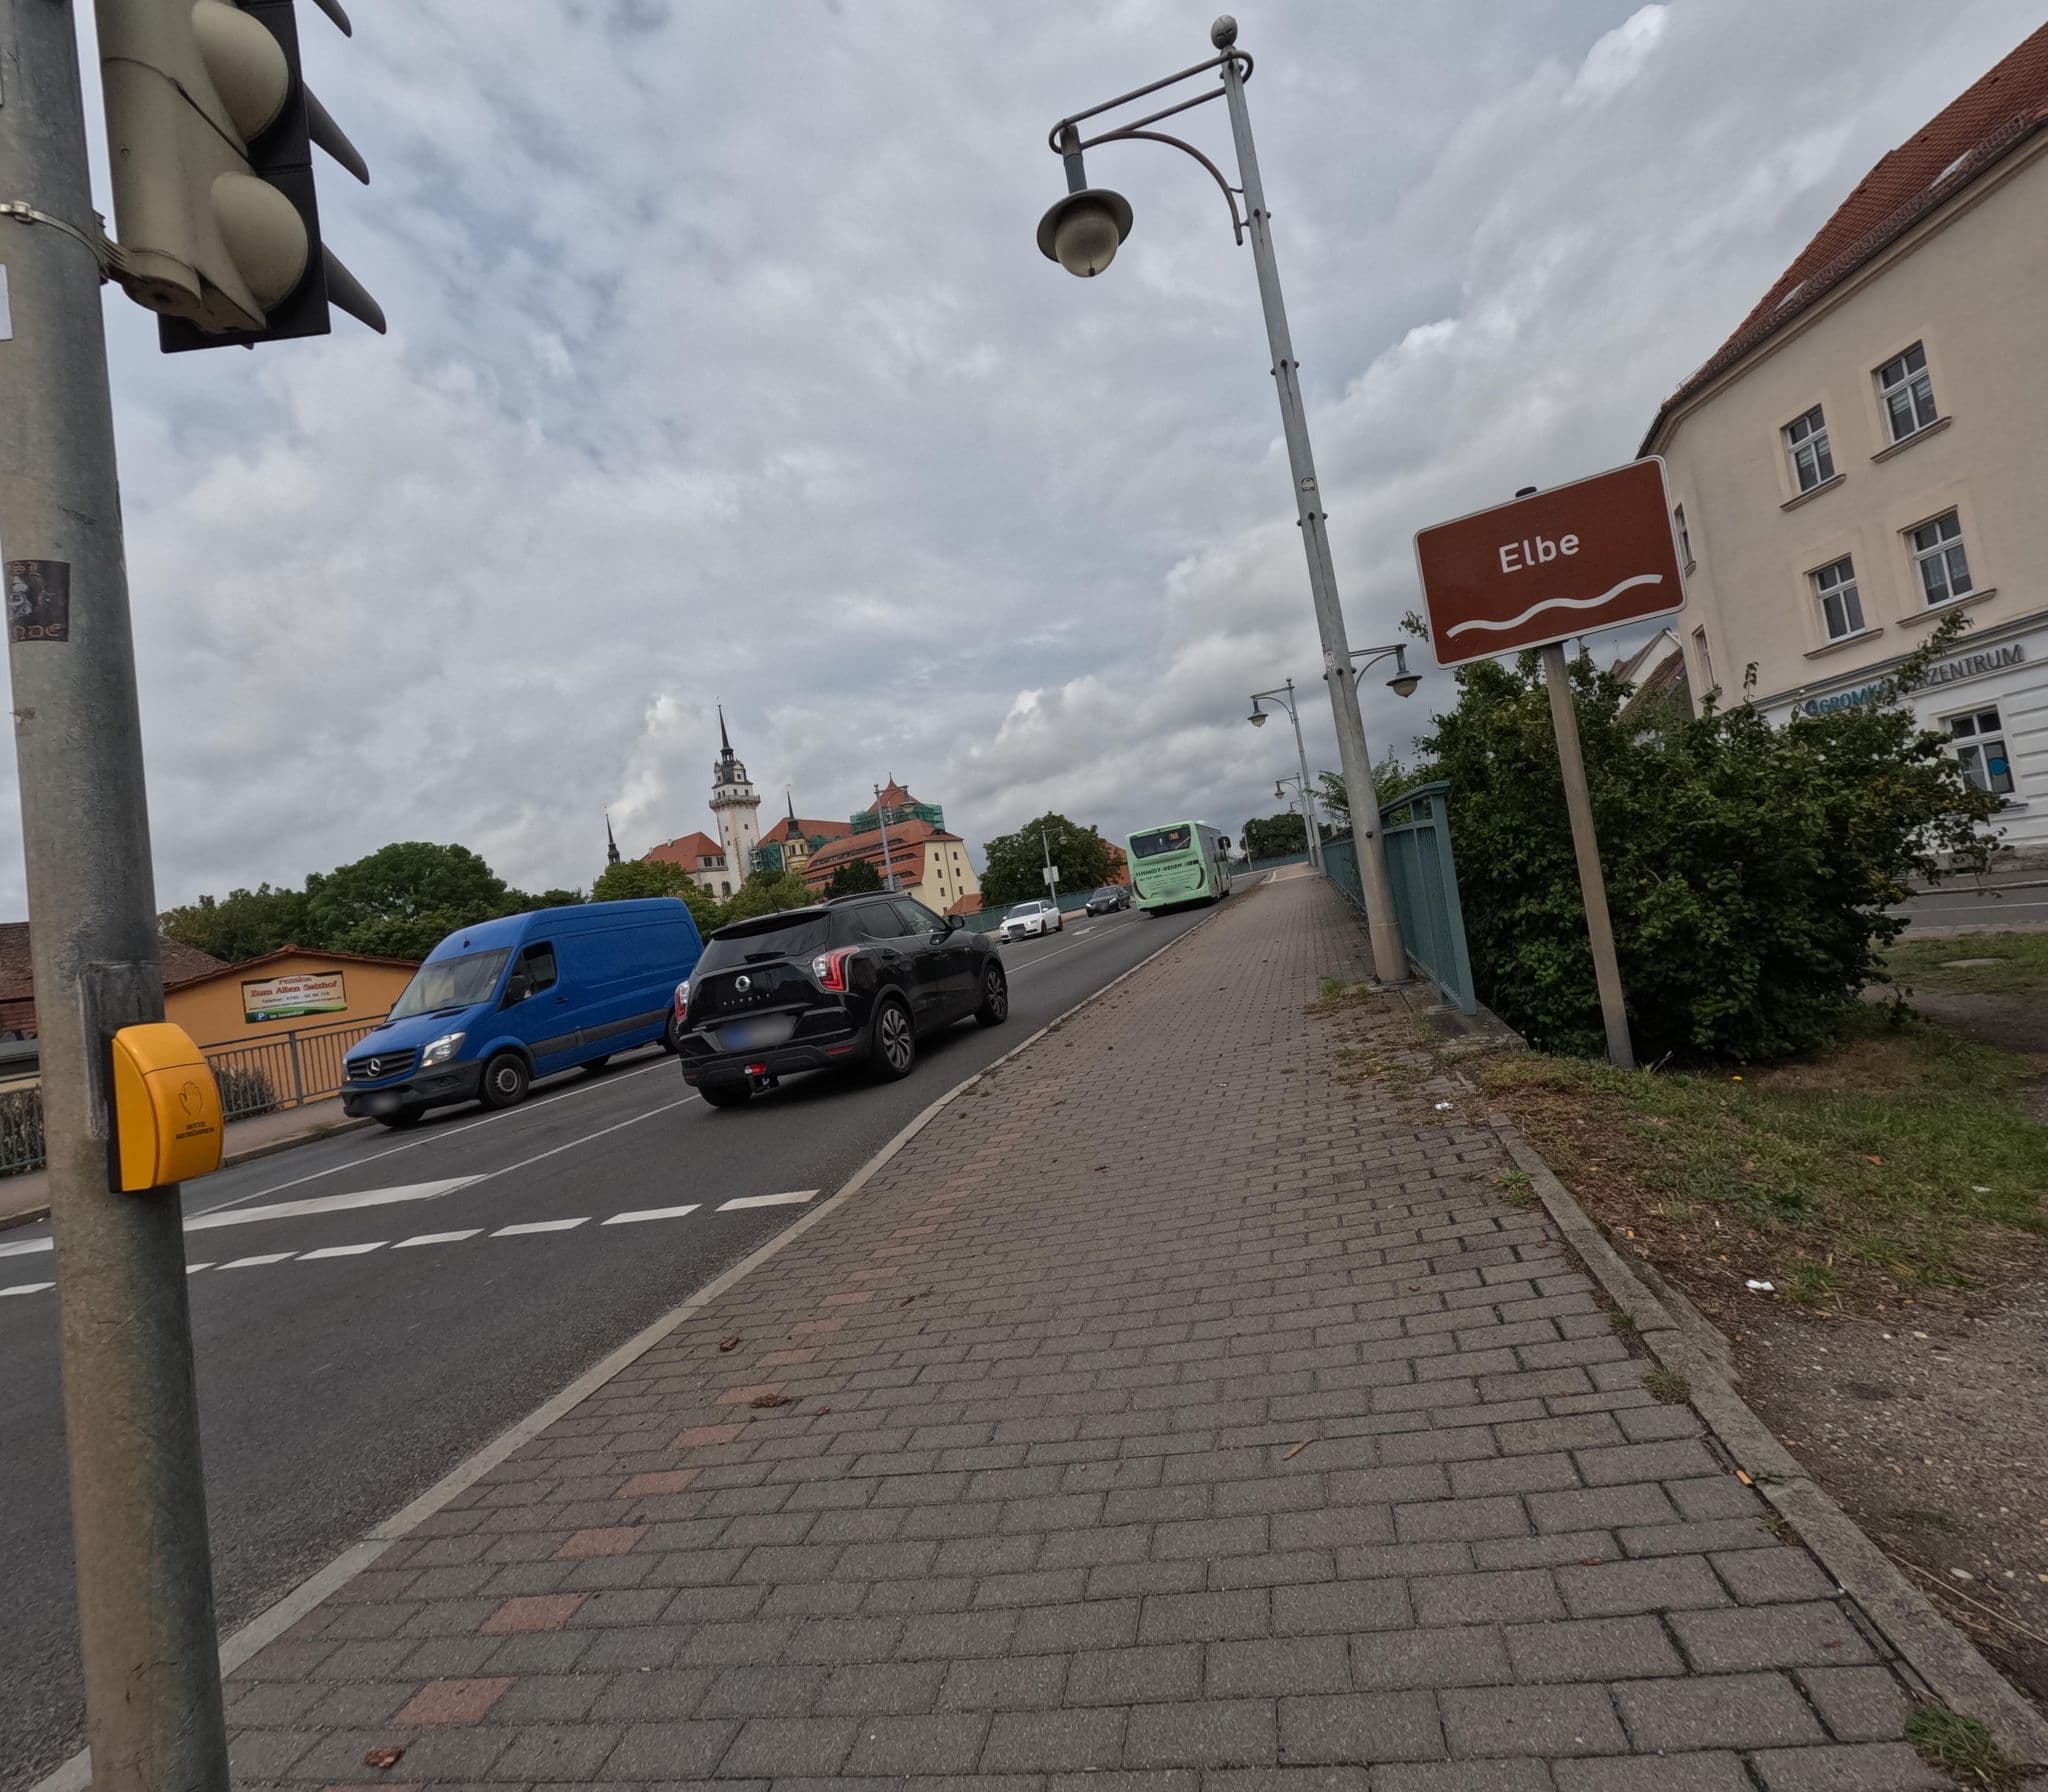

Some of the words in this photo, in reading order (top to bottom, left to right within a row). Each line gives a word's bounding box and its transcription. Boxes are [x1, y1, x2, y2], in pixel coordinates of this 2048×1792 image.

[1499, 533, 1580, 574] Elbe
[1920, 644, 2025, 685] ZENTRUM
[250, 989, 272, 998] Zum
[275, 985, 301, 994] Alten
[303, 981, 338, 992] Salzhof
[279, 975, 312, 985] Pension
